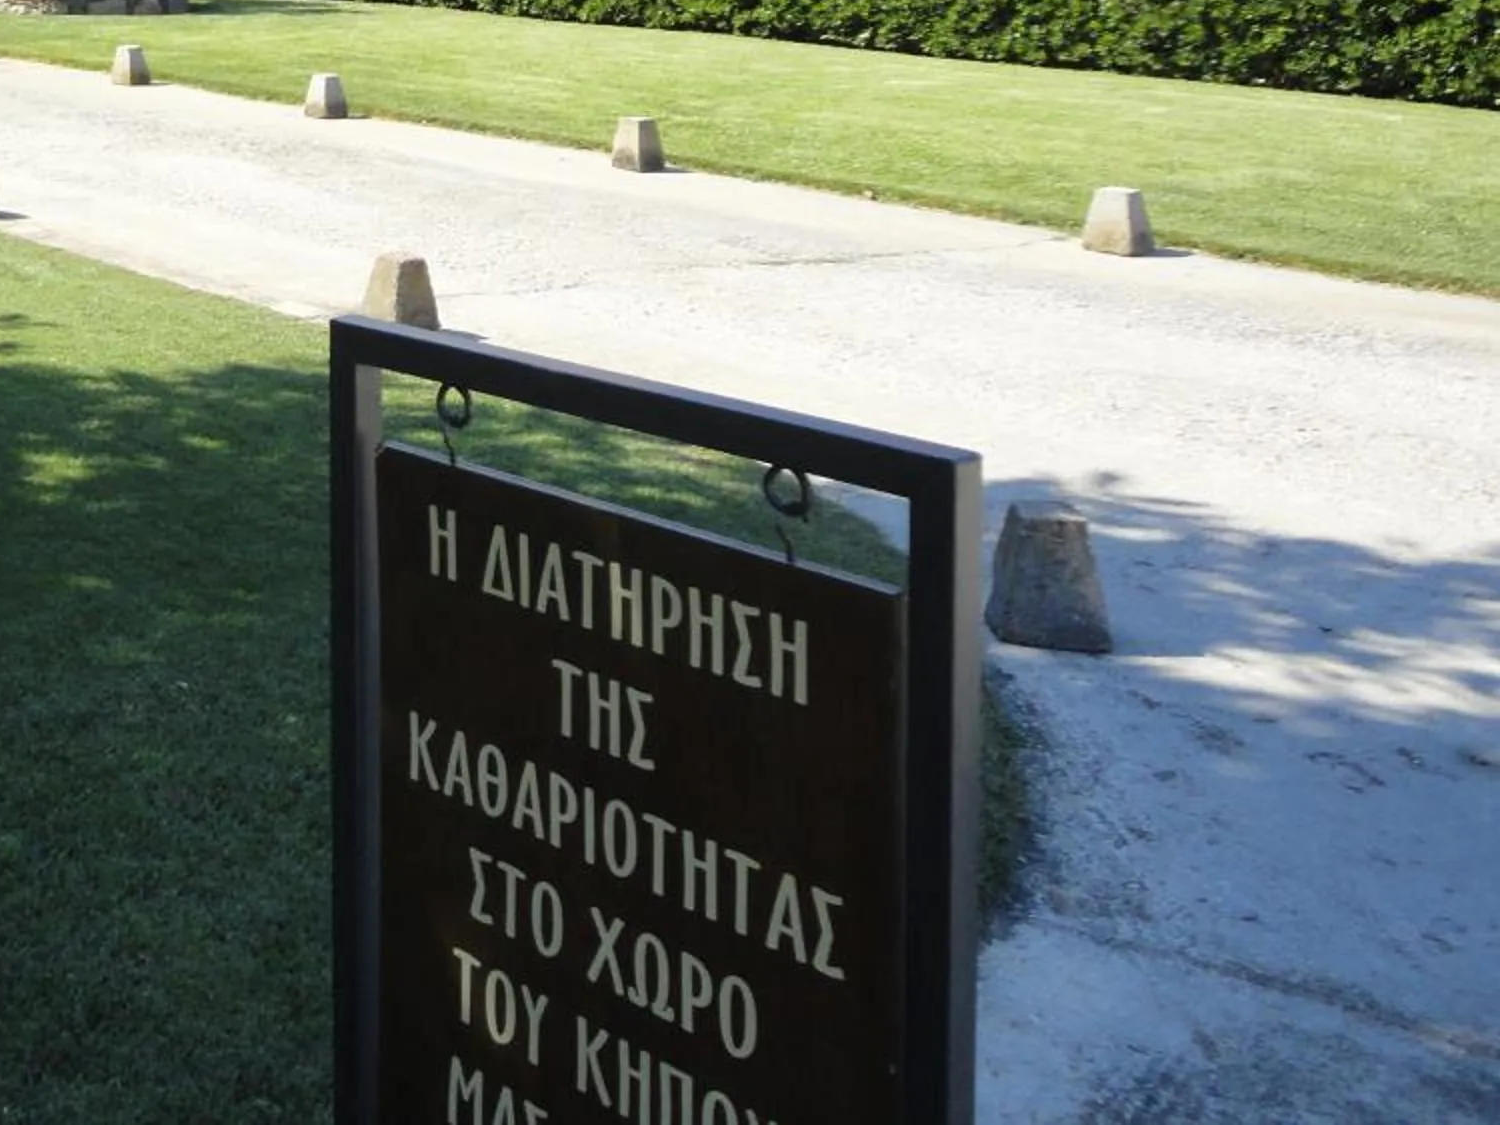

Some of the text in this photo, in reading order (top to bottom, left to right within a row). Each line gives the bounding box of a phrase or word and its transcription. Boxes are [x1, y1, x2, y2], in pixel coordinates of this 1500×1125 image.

[428, 504, 808, 706] Η ΔΙΑΤΗΡΗΣΗ
[551, 658, 656, 771] ΤΗΣ
[409, 710, 845, 980] ΚΑΘΑΡΙΟΤΗΤΑΣ
[451, 946, 778, 1125] ΤΟΥ ΚΗΠ
[469, 846, 758, 1059] ΣΤΟ ΧΩΡΟ
